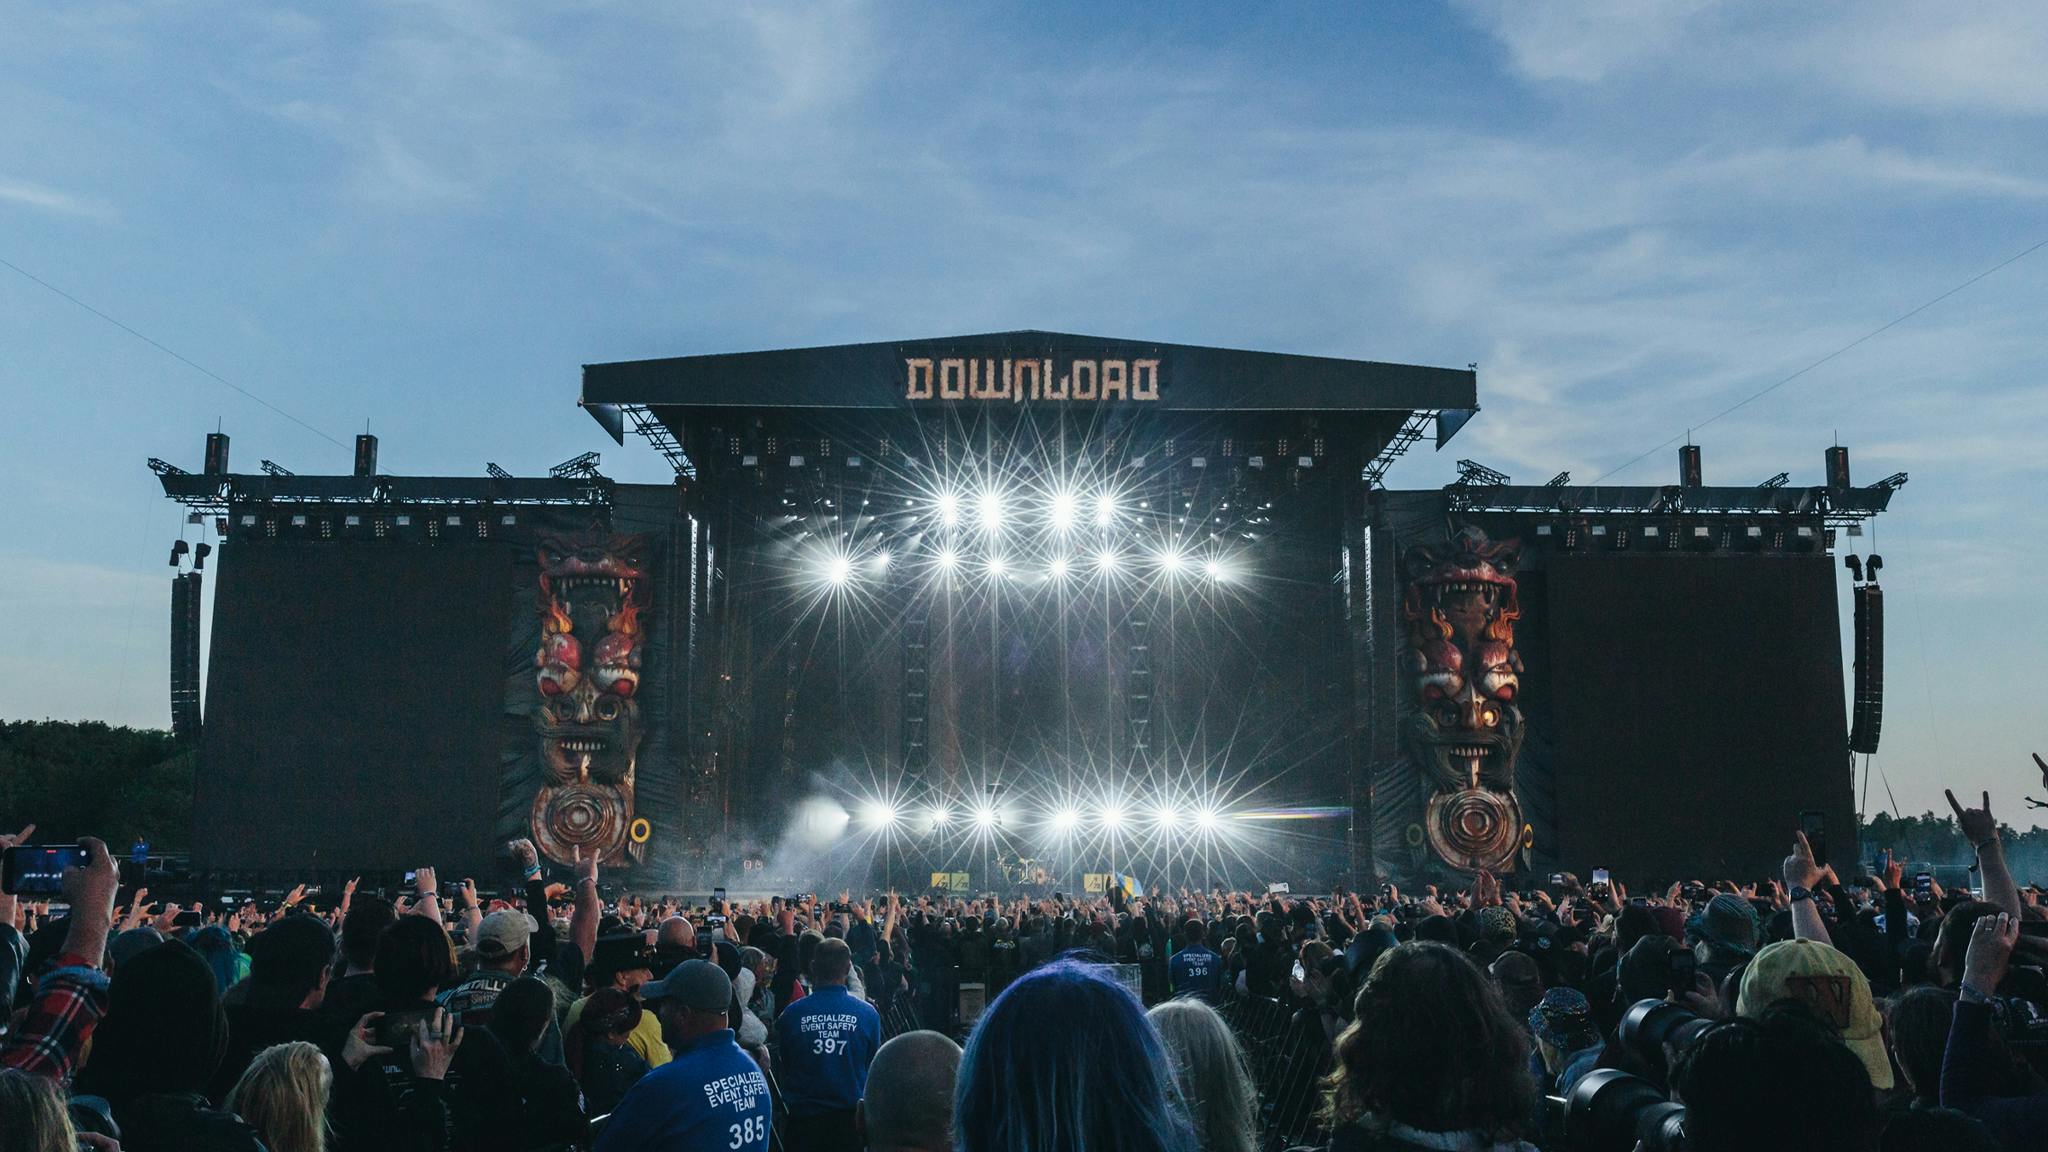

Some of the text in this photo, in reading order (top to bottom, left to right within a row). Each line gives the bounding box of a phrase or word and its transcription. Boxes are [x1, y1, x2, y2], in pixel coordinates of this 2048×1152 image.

[905, 357, 1161, 403] DOWNLOAD
[1188, 967, 1208, 977] 396
[801, 1014, 858, 1024] SPECIALIZED
[801, 1022, 858, 1032] EVENT SAFETY
[819, 1030, 840, 1039] TEAM
[813, 1038, 848, 1055] 397
[703, 1071, 765, 1096] SPECIALIZE
[709, 1086, 741, 1108] EVENT
[733, 1096, 756, 1112] TEAM
[729, 1115, 765, 1150] 385
